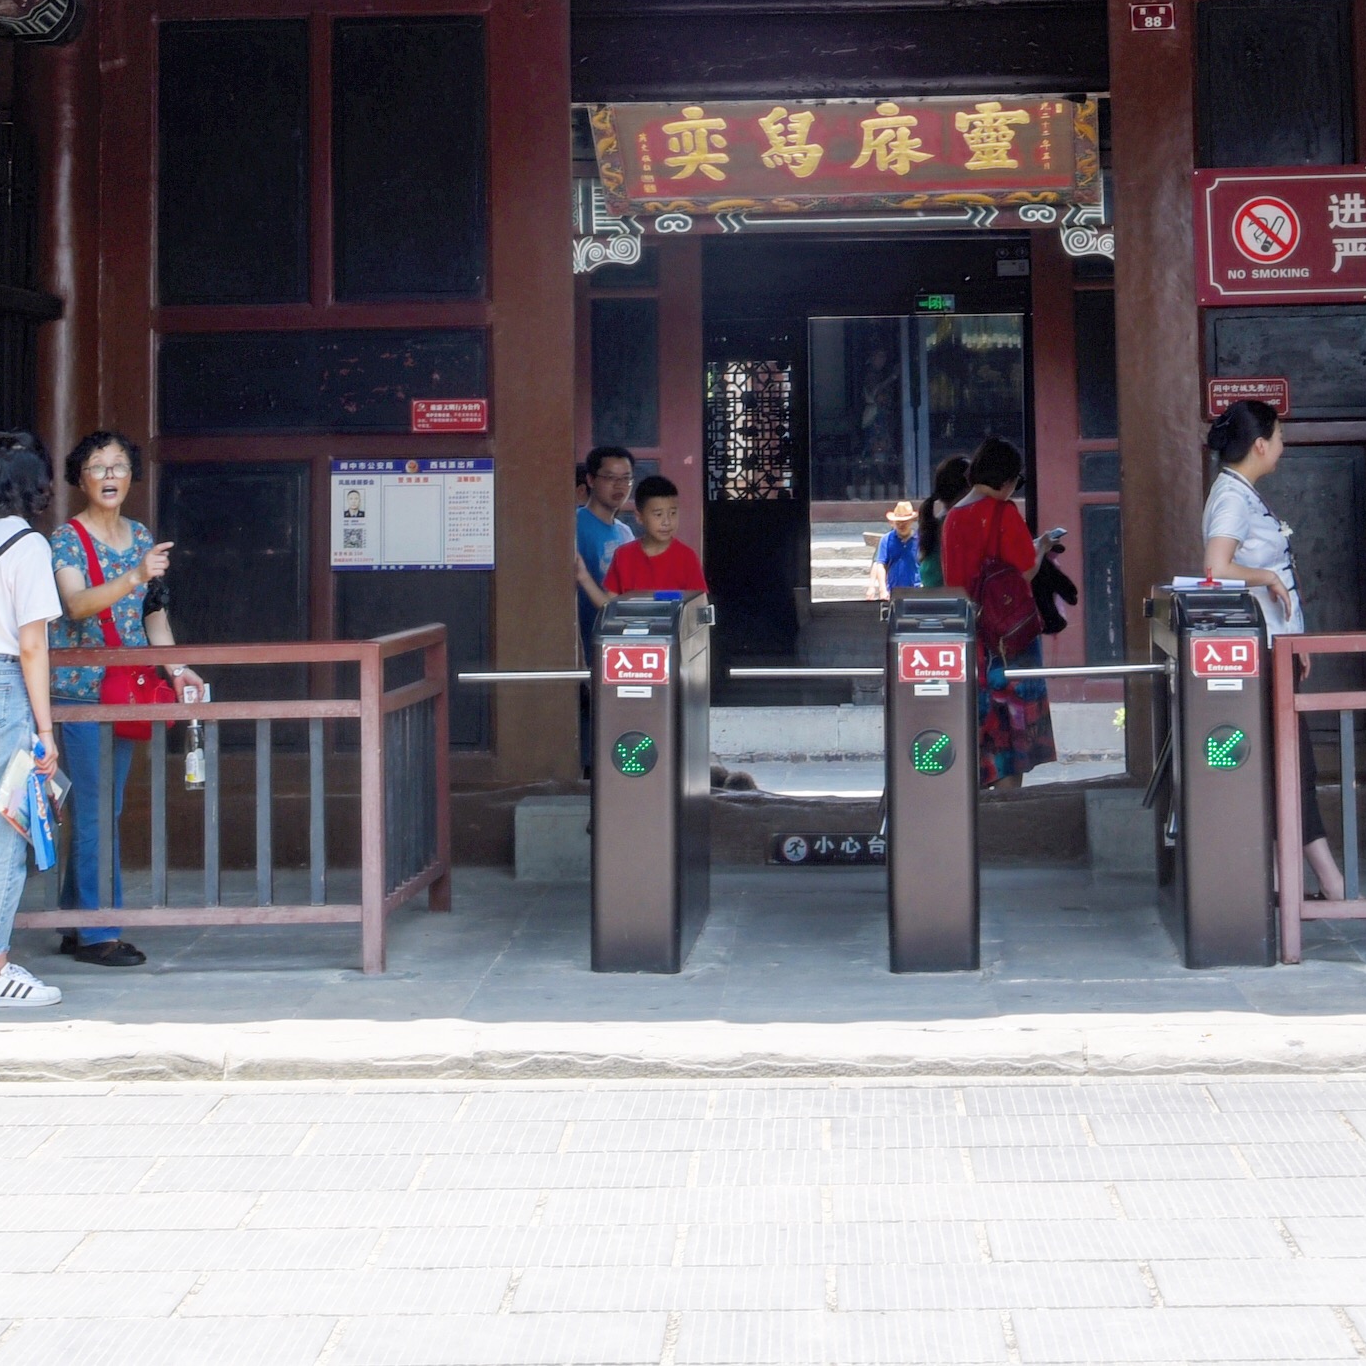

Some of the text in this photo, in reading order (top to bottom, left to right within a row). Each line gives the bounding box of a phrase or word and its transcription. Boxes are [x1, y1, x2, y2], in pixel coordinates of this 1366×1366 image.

[1227, 267, 1310, 280] NO SMOKING
[910, 649, 955, 668] 入口
[1202, 644, 1248, 663] 入口
[614, 651, 658, 670] 入口
[914, 668, 950, 677] Entrance
[1207, 663, 1243, 672] Entrance
[618, 670, 653, 679] Entrance
